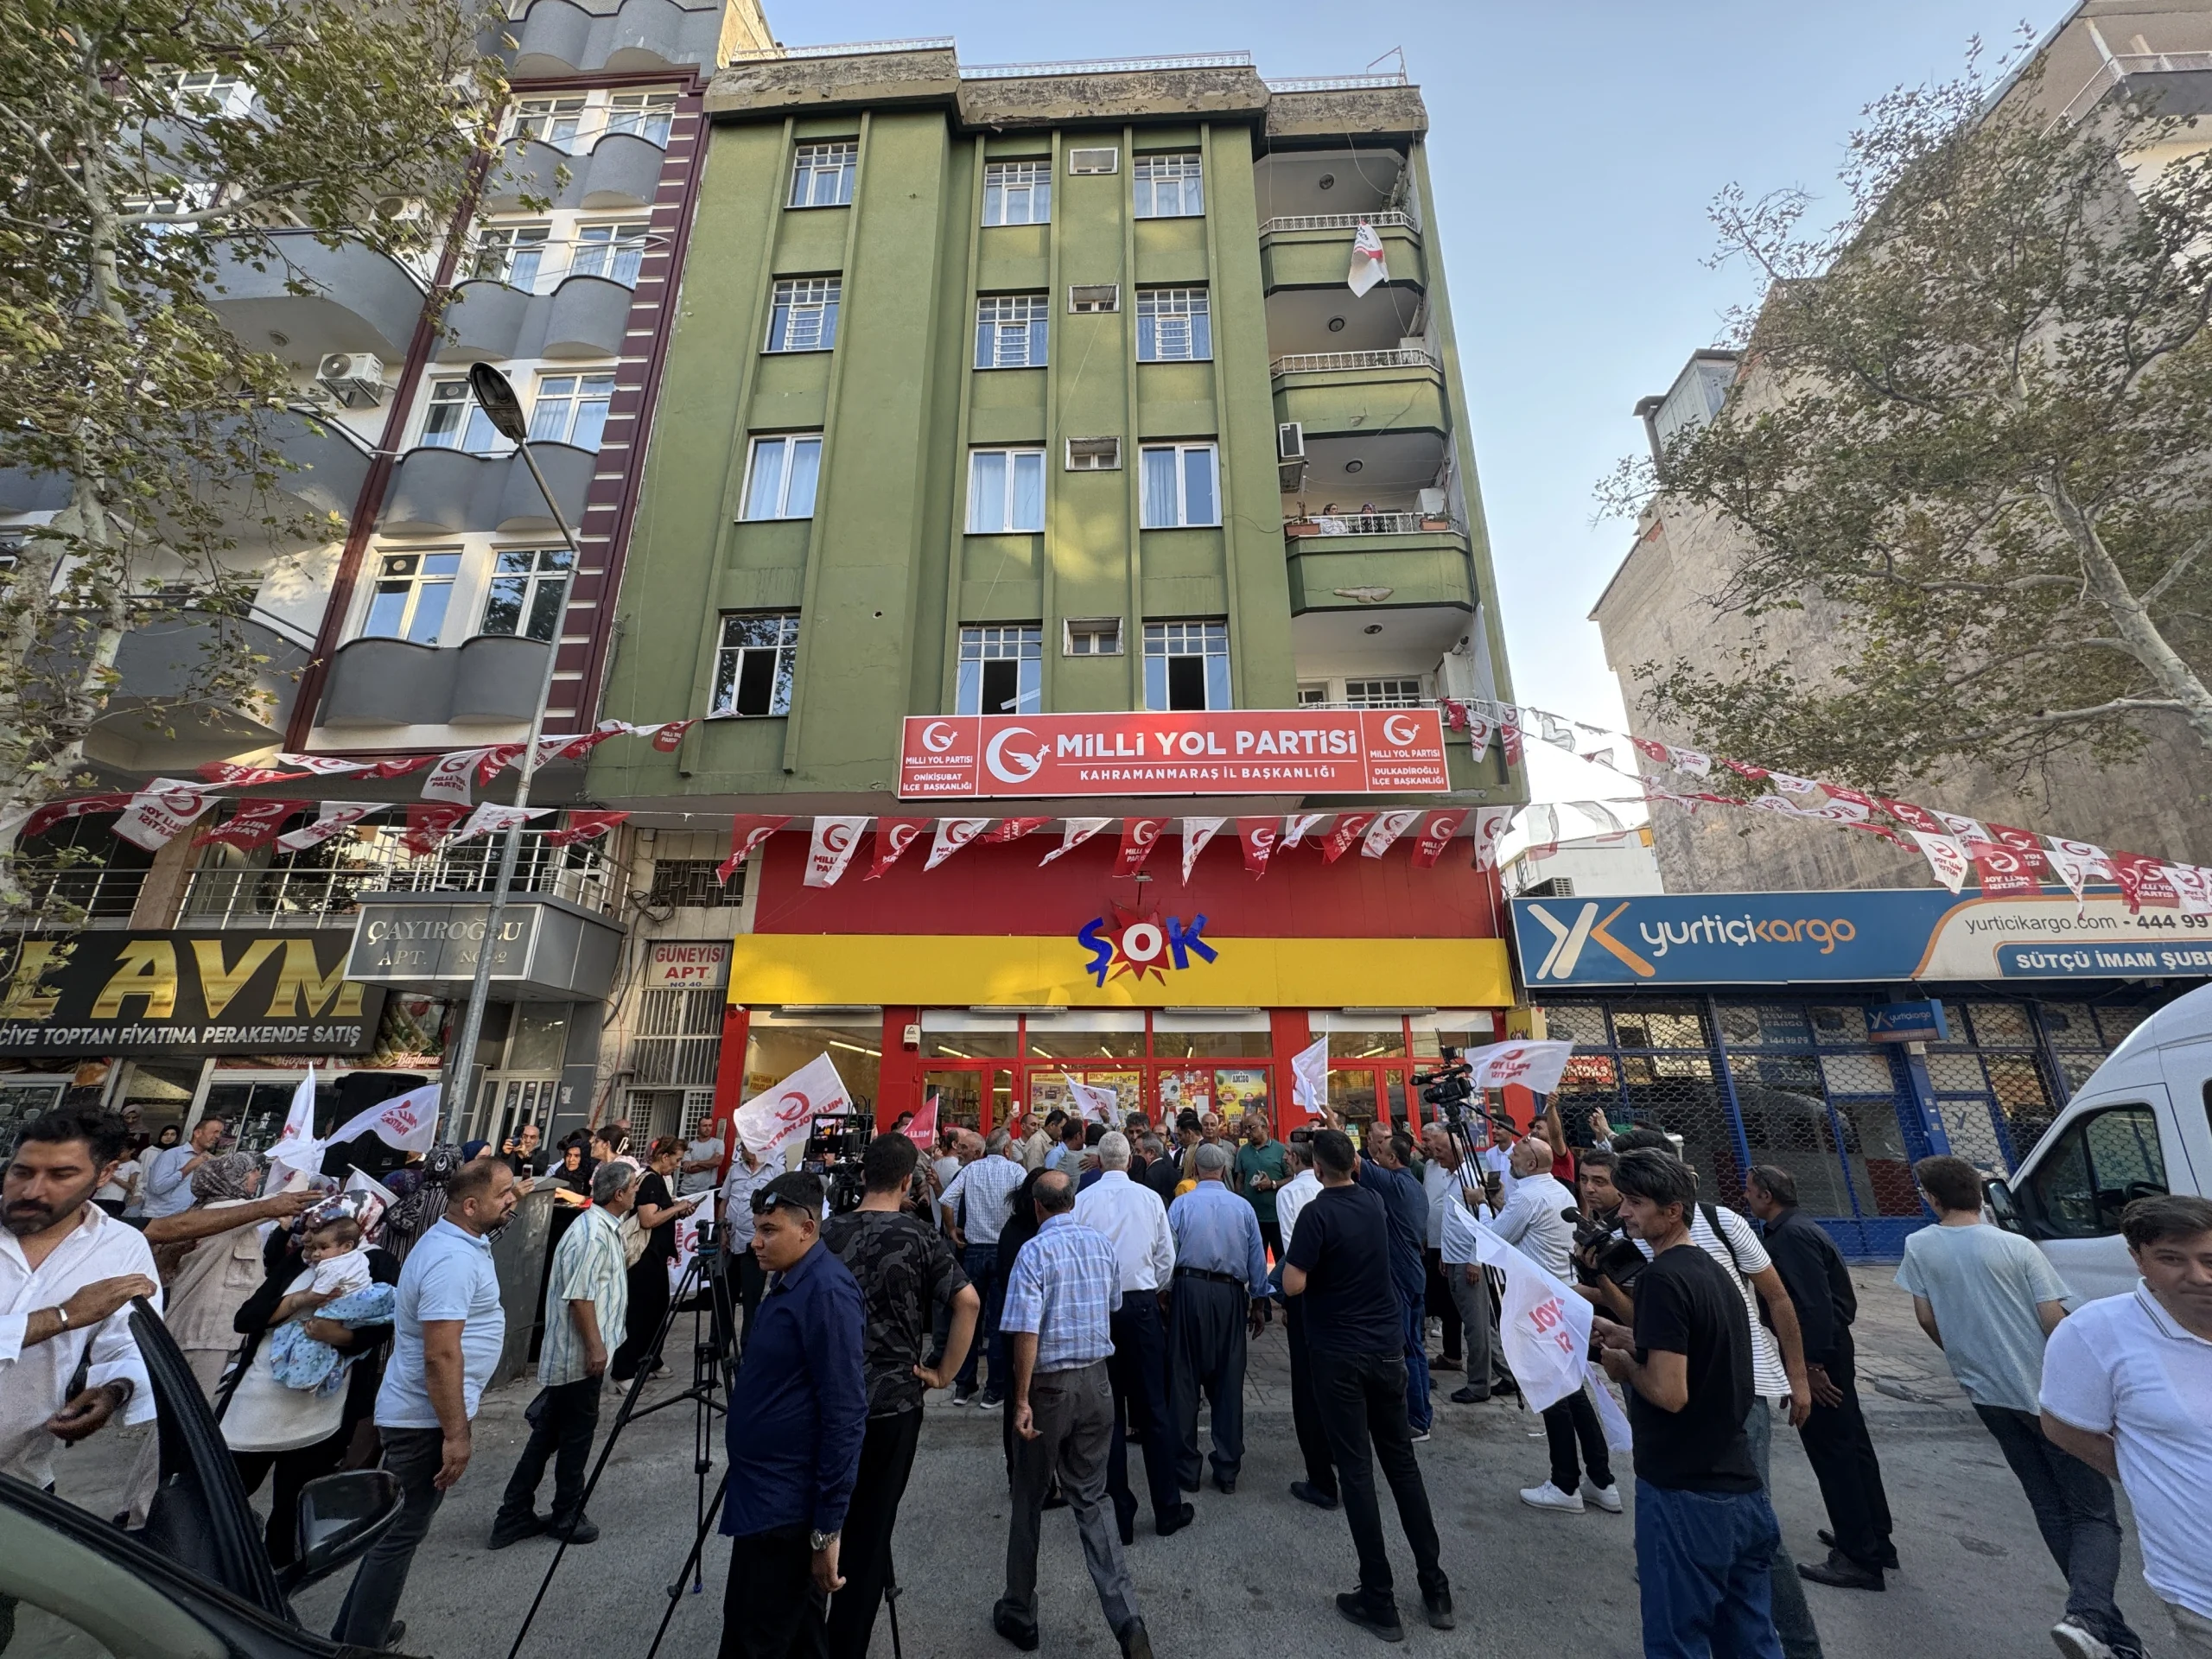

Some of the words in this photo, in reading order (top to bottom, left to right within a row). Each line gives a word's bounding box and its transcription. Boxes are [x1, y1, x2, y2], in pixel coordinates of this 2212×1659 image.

[1154, 731, 1226, 756] YOL
[1393, 749, 1410, 758] YOL
[913, 772, 963, 782] ONİKİŞUBAT
[1080, 767, 1218, 782] KAHRAMANMARAŞ
[1223, 766, 1236, 779] İL
[1239, 765, 1336, 780] BAŞKANLIĞI
[1374, 766, 1440, 775] DULKADİROĞLU
[903, 783, 920, 791] İLÇE
[924, 781, 972, 791] BAŞKANLIĞI
[1372, 776, 1390, 785] İLÇE
[1394, 776, 1444, 785] BAŞKANLIĞI
[367, 918, 524, 945] ÇAYIROĞU
[1965, 915, 2117, 935] yurticikargo.com
[2136, 914, 2177, 929] 444
[2181, 914, 2209, 929] 99
[656, 944, 727, 963] GÜNEYİSİ
[1077, 912, 1219, 988] ŞOK
[2015, 951, 2091, 972] SÜTÇÜ
[2094, 950, 2158, 969] İMAM
[90, 939, 366, 1020] AVM
[44, 1027, 117, 1046] TOPTAN
[118, 1023, 197, 1046] FİYATINA
[203, 1026, 307, 1045] PERAKENDE
[312, 1026, 362, 1047] SATIŞ
[397, 1052, 442, 1069] Bazlama
